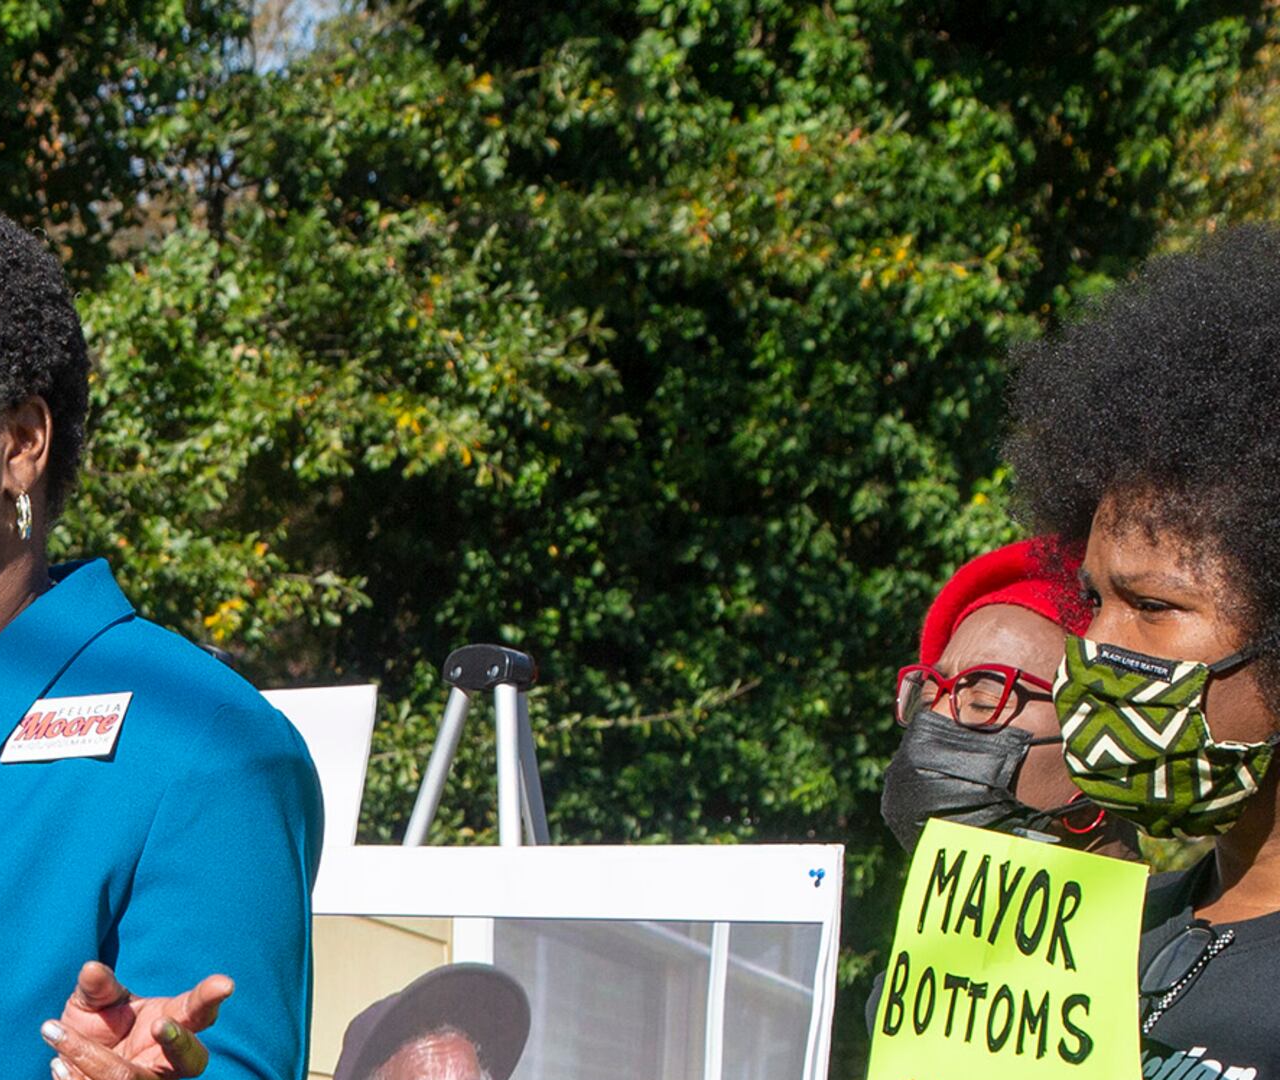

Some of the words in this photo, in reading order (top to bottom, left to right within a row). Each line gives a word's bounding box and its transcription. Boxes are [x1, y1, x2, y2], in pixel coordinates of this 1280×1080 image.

[14, 712, 119, 741] Moore
[59, 704, 121, 716] FELICIA
[918, 845, 1081, 972] MAYOR
[882, 950, 1093, 1066] BOTTOMS
